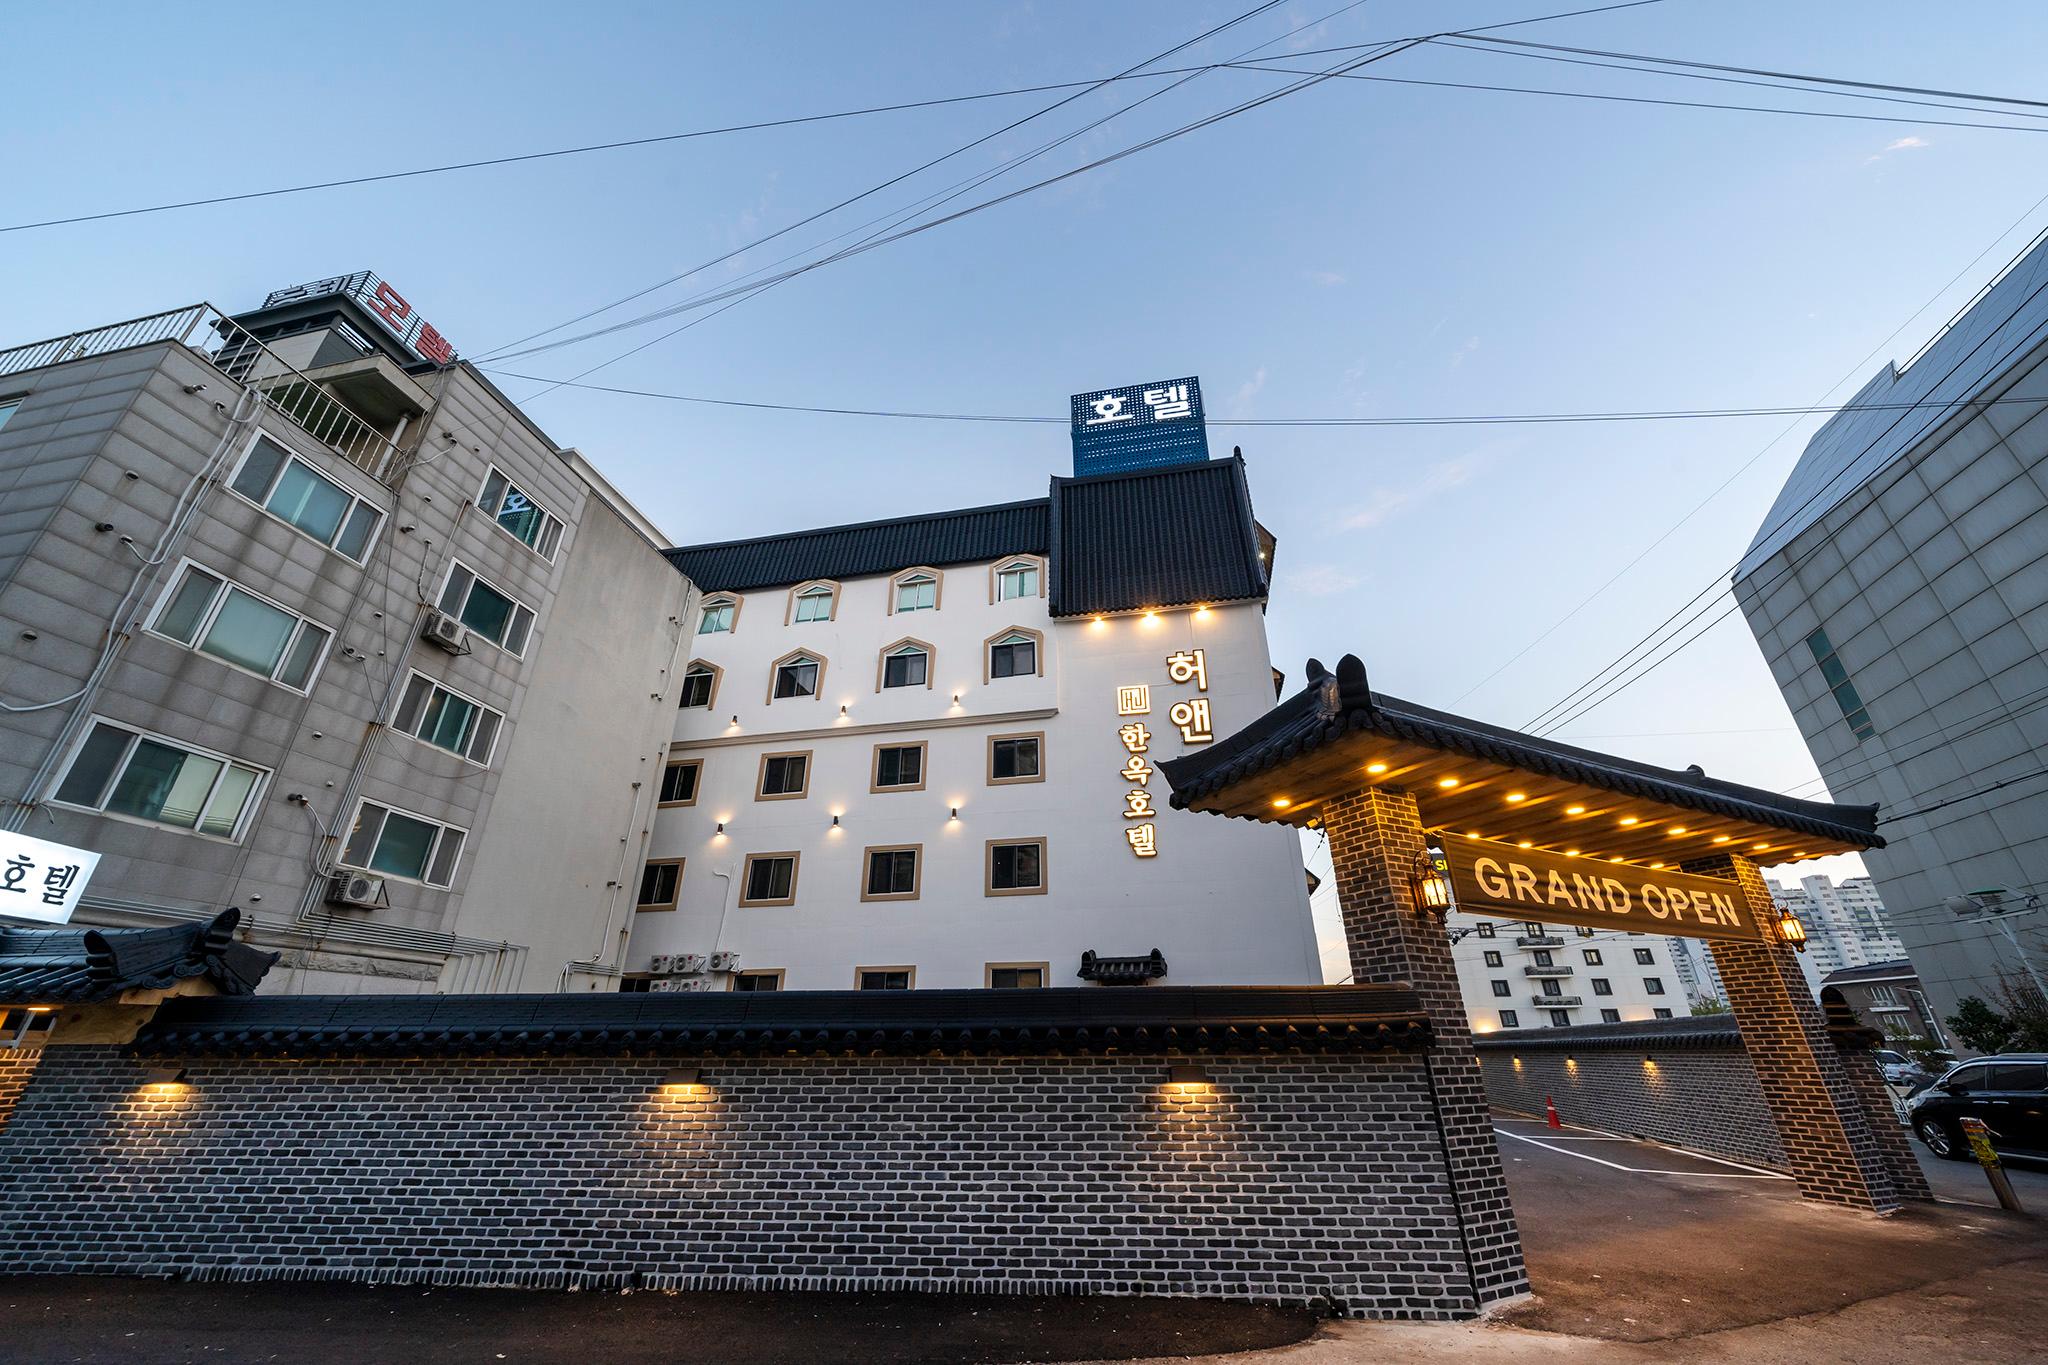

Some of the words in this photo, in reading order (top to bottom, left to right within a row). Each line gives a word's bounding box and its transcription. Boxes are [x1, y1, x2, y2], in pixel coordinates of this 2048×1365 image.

[367, 281, 452, 364] 모텔
[1086, 385, 1192, 425] 호텔
[1166, 649, 1213, 744] 허앤
[1118, 722, 1157, 857] 한옥호텔
[0, 854, 80, 906] 호텔
[1474, 857, 1632, 914] GRAND
[1641, 883, 1741, 927] OPEN
